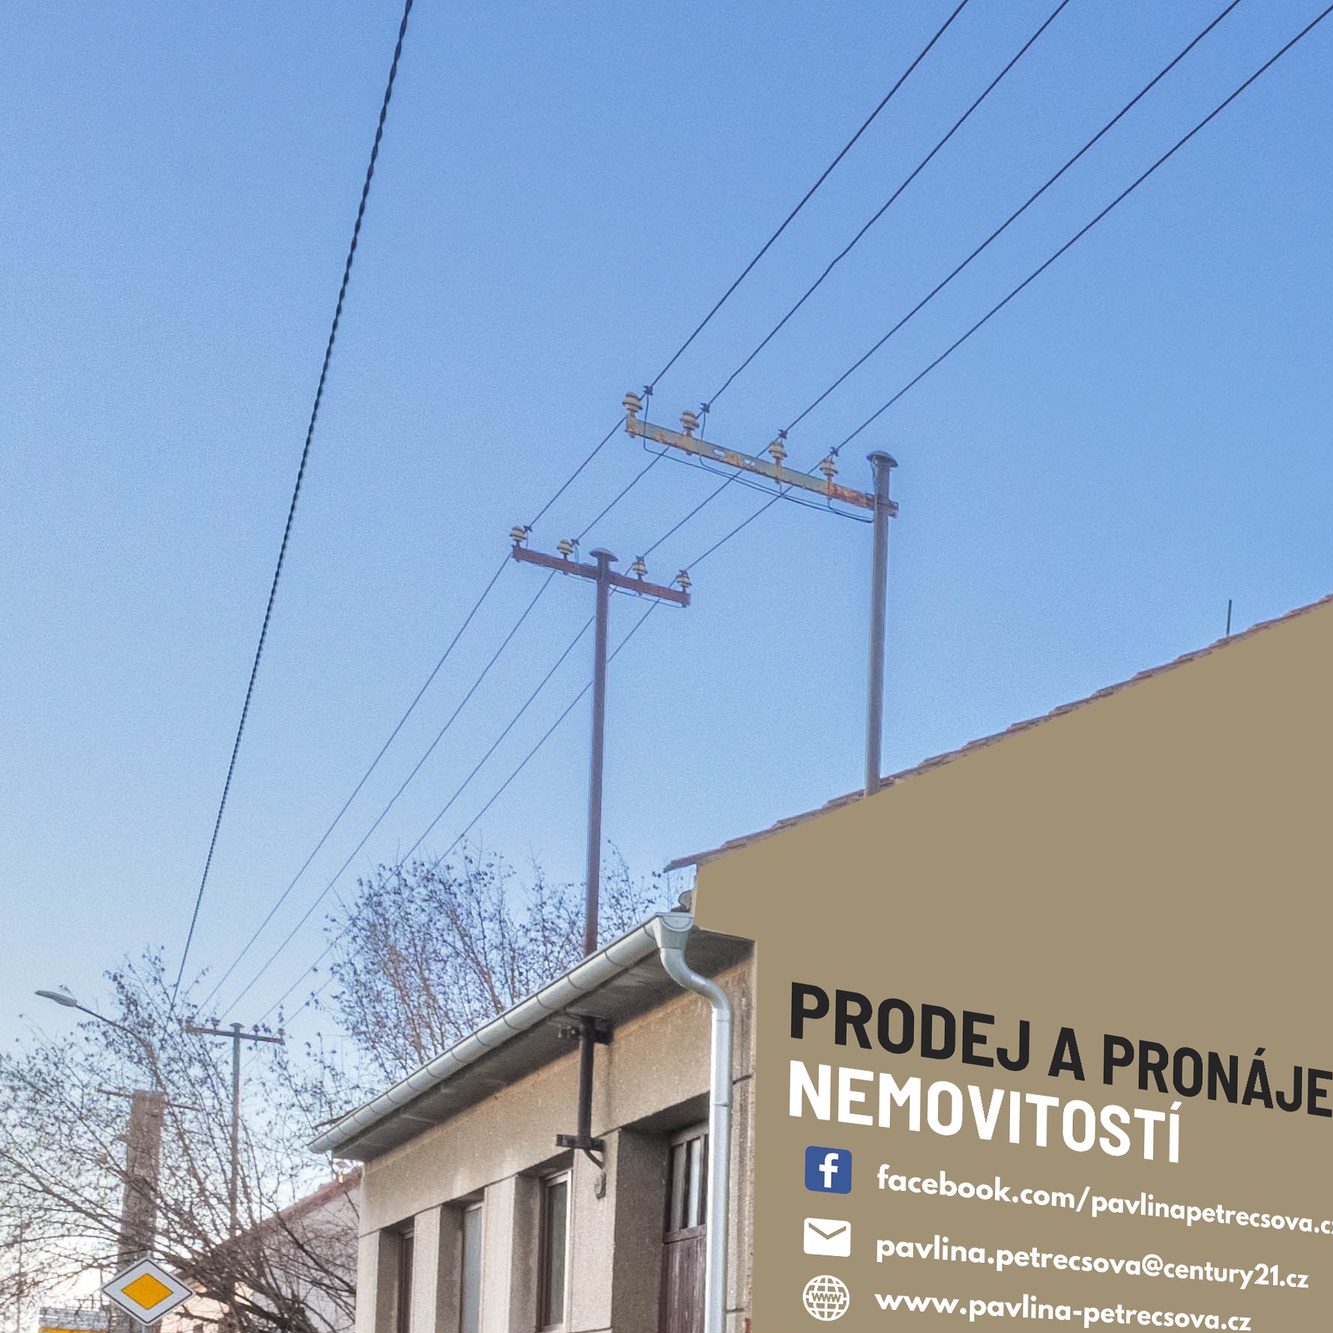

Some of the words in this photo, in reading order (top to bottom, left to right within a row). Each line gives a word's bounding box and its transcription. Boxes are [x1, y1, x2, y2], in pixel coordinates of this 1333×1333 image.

[790, 981, 1030, 1072] PRODEJ
[1047, 1026, 1086, 1082] A
[789, 1059, 1183, 1164] NEMOVITOSTÍ
[876, 1234, 1309, 1290] pavlina.petrecsova@century21.cz
[874, 1292, 1252, 1332] www.pavlina-petrecsova.cz
